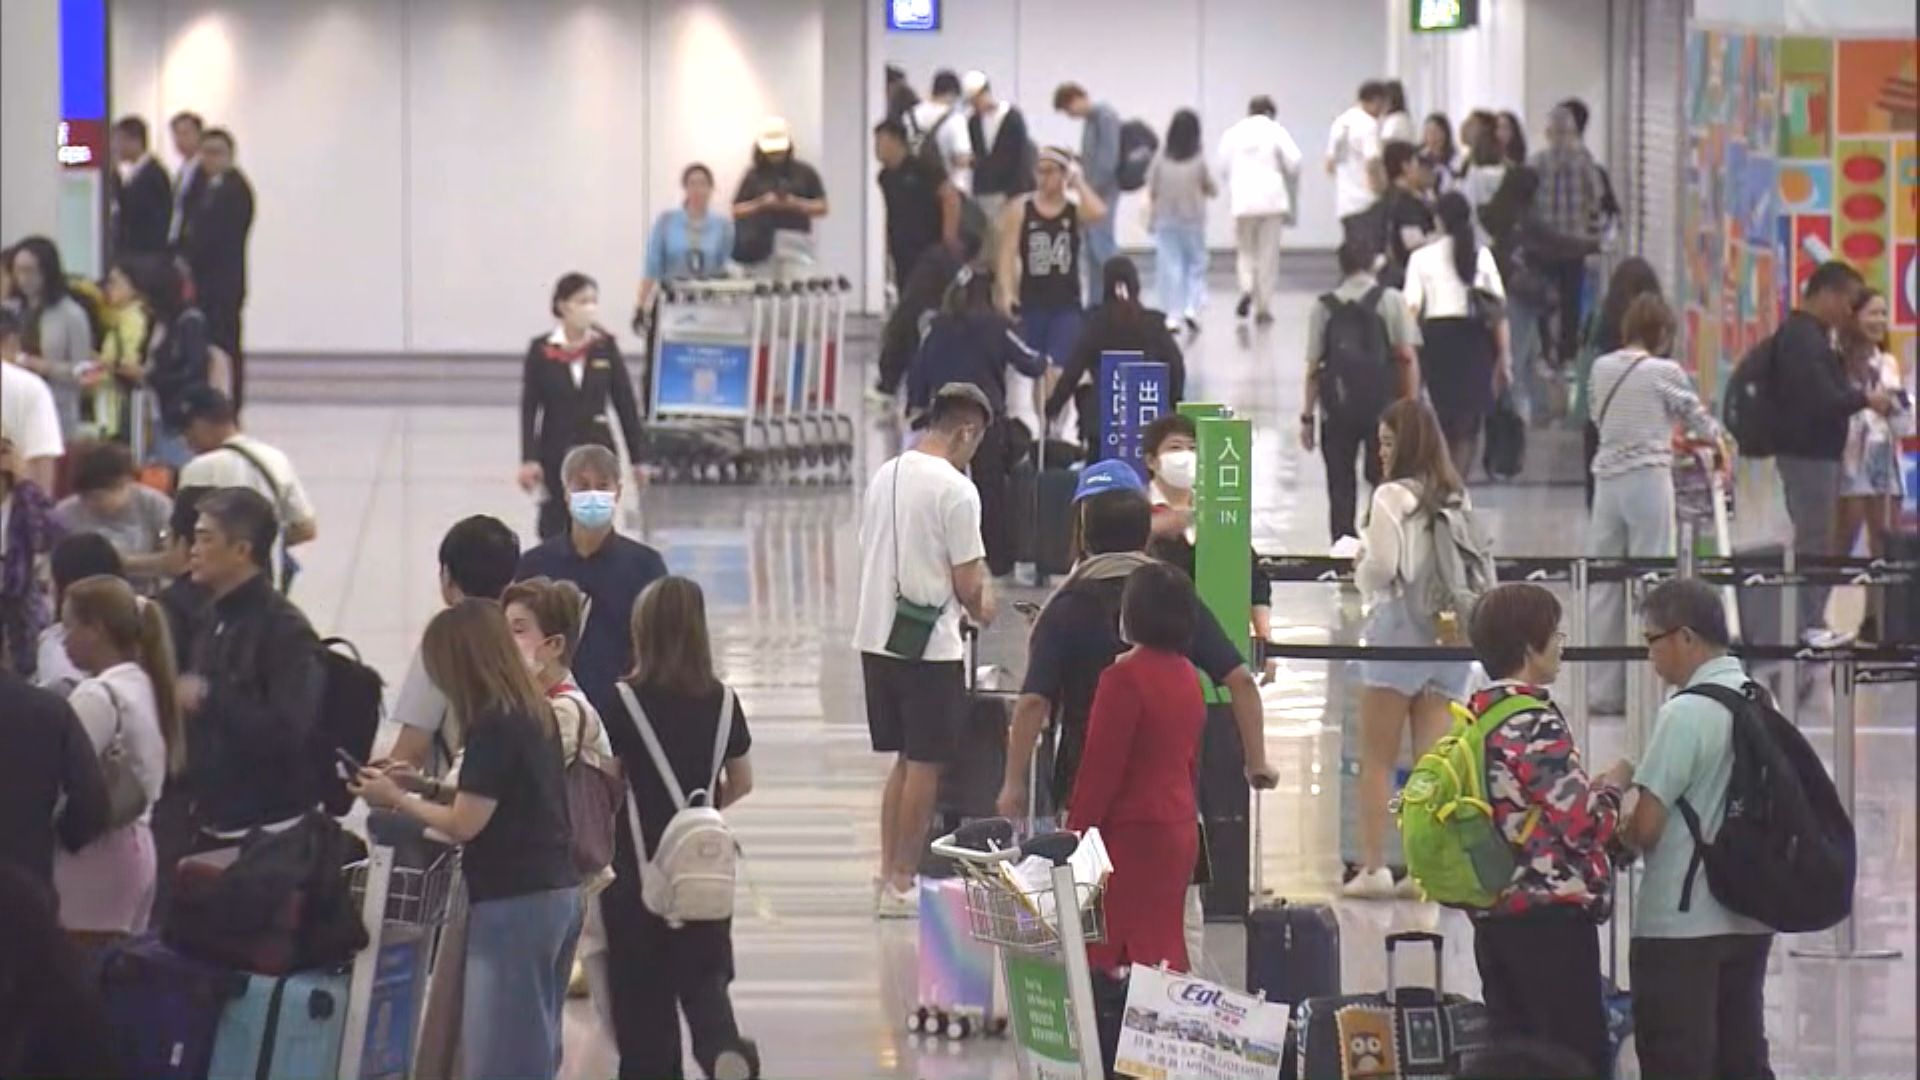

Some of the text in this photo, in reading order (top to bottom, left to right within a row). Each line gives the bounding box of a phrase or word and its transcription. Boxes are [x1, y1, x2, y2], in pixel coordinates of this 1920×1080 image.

[1029, 231, 1072, 276] 24
[1139, 379, 1159, 427] 出口
[1218, 437, 1241, 488] 入口
[1220, 510, 1238, 525] IN
